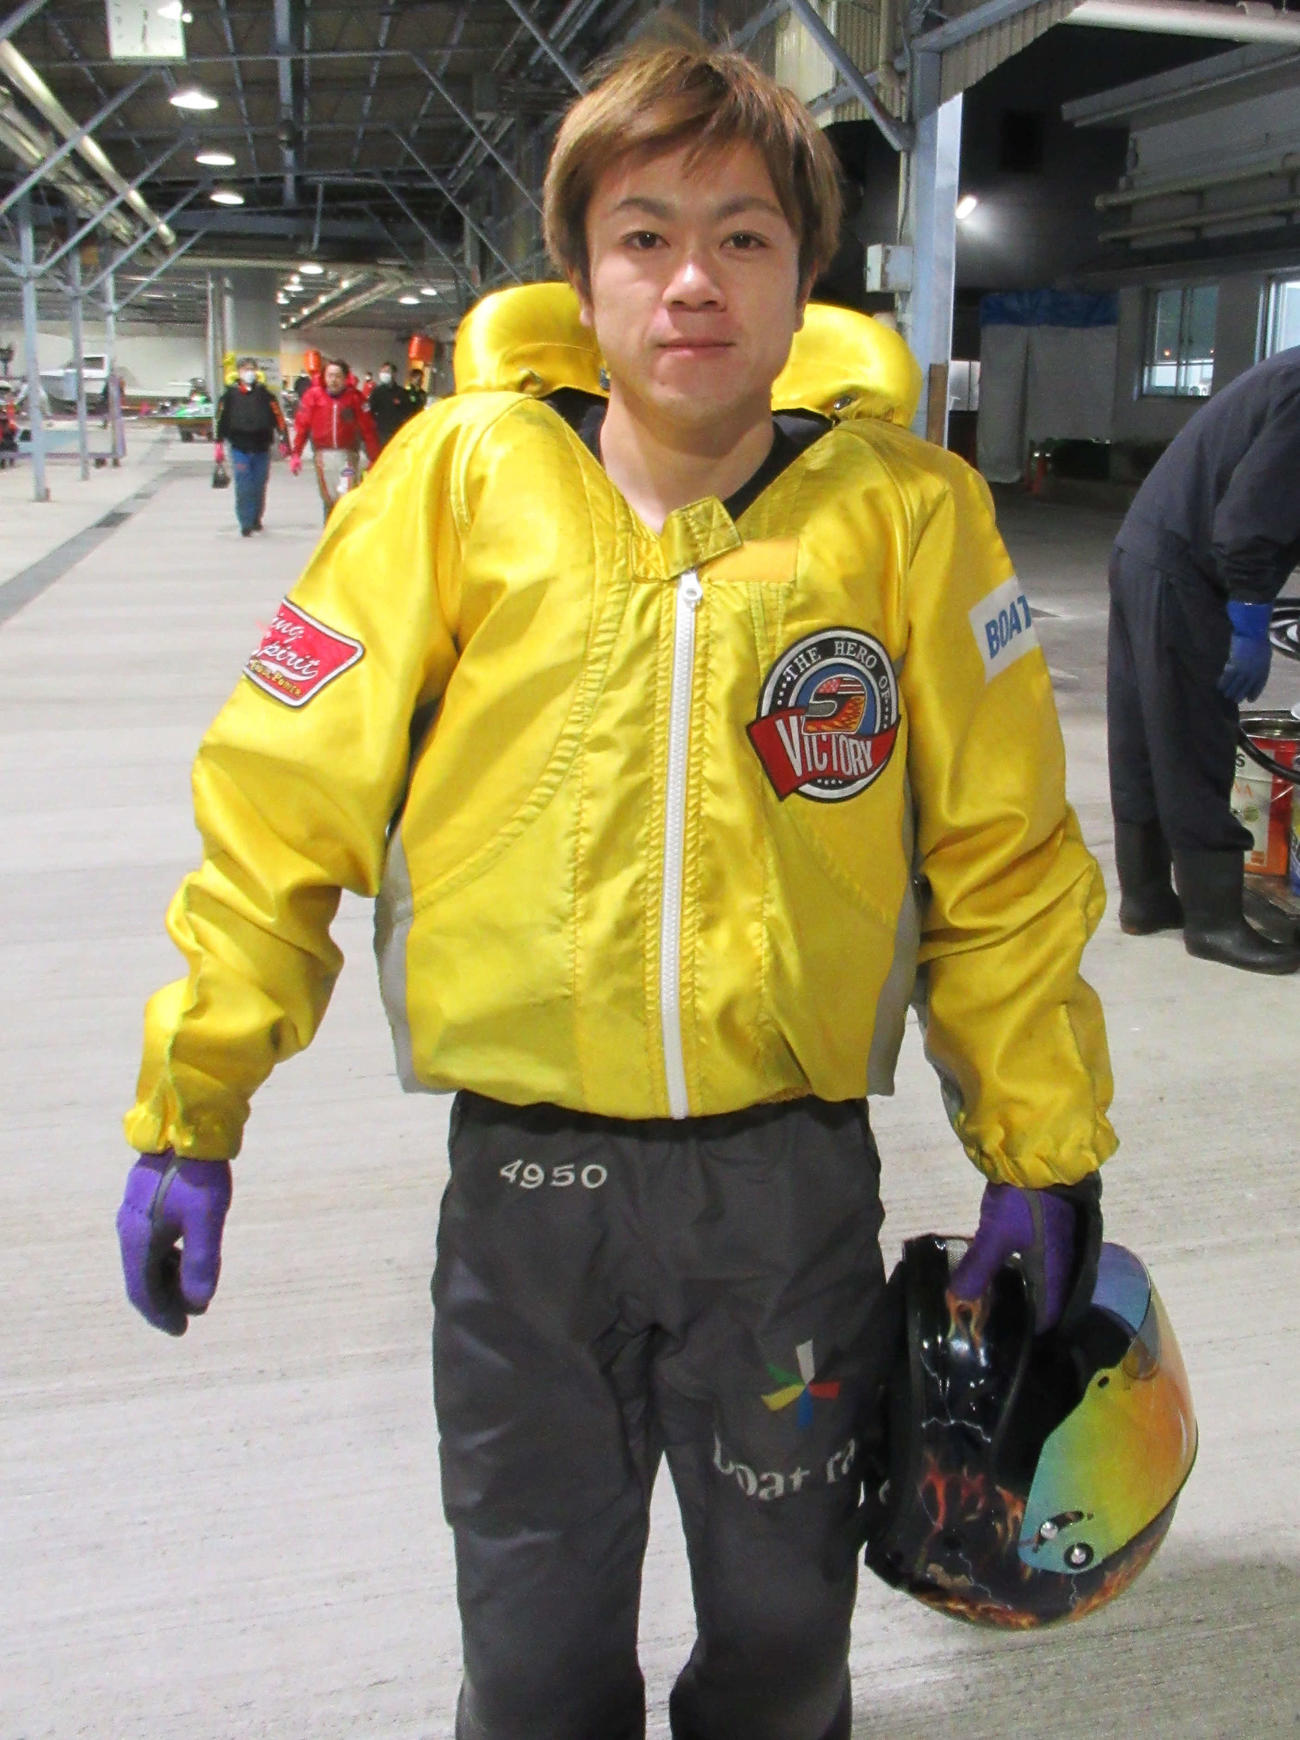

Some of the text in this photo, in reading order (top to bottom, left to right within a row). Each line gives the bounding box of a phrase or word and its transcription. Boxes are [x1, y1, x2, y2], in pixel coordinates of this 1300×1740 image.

[985, 594, 1032, 660] BOAT
[784, 640, 892, 702] THE HERO OF
[775, 714, 873, 777] VICTORY
[500, 1159, 608, 1189] 4950
